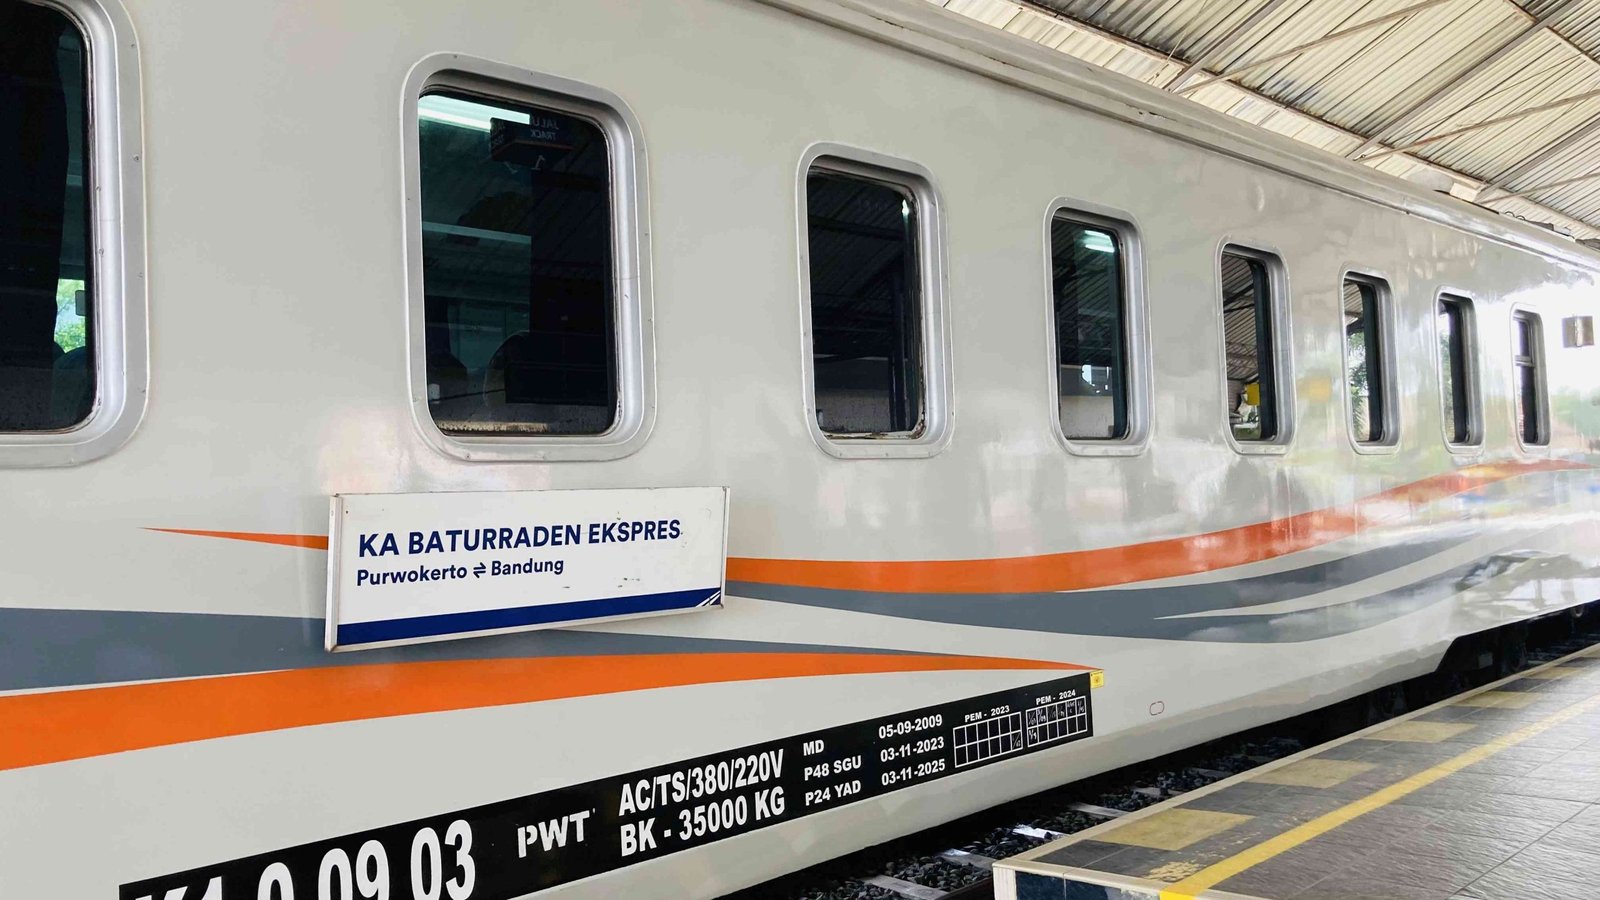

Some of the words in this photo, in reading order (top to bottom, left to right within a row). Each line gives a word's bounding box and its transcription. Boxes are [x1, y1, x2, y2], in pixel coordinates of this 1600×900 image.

[359, 532, 400, 558] KA
[408, 524, 582, 555] BATURRADEN
[588, 519, 681, 545] EKSPRES
[356, 564, 468, 587] Purwokerto
[491, 557, 564, 577] Bandung
[1035, 694, 1052, 706] PEM
[1058, 689, 1076, 700] 2024
[878, 713, 943, 739] 05-09-2009
[964, 711, 983, 723] PEM
[990, 704, 1010, 717] 2023
[803, 739, 825, 756] MD
[880, 736, 945, 763] 03-11-2023
[804, 762, 830, 781] P48
[833, 755, 862, 774] SGU
[881, 758, 946, 786] 03-11-2025
[618, 749, 784, 817] AC/TS/380/220V
[805, 786, 831, 806] P24
[833, 780, 862, 798] YAD
[517, 810, 590, 859] PWT
[620, 818, 658, 857] BK
[678, 795, 748, 841] 35000
[755, 786, 786, 821] KG
[317, 839, 390, 900] 09
[410, 819, 476, 900] 03
